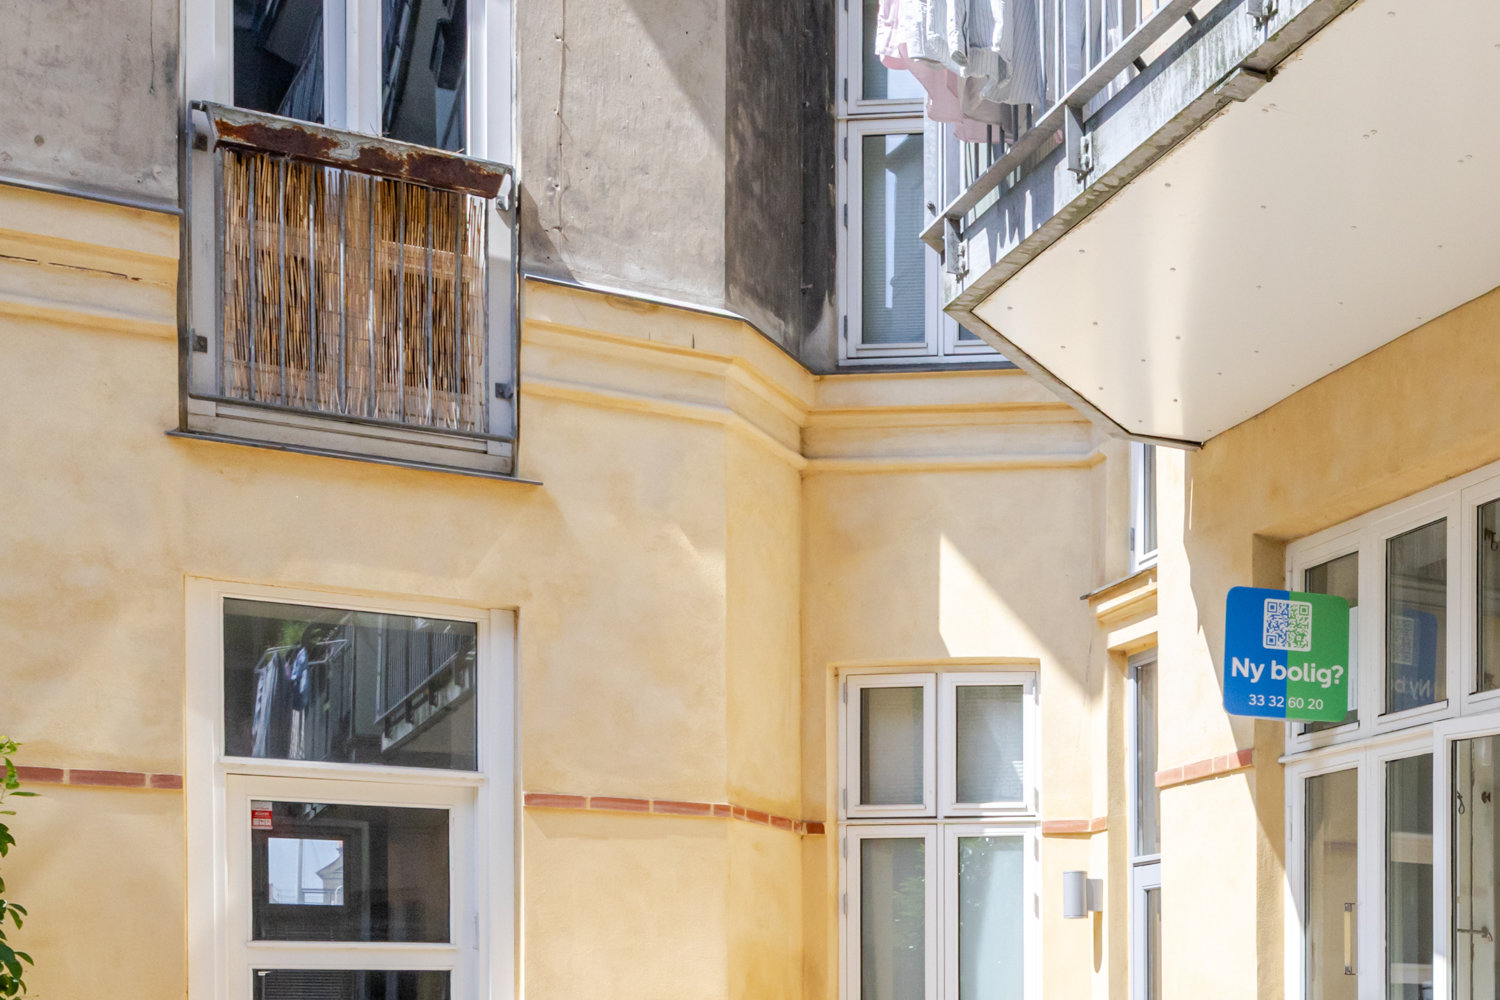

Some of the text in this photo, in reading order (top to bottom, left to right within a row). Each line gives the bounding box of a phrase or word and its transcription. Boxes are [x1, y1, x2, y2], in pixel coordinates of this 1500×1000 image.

[1231, 657, 1344, 688] Ny bolig?
[1248, 694, 1324, 710] 33 32 60 20
